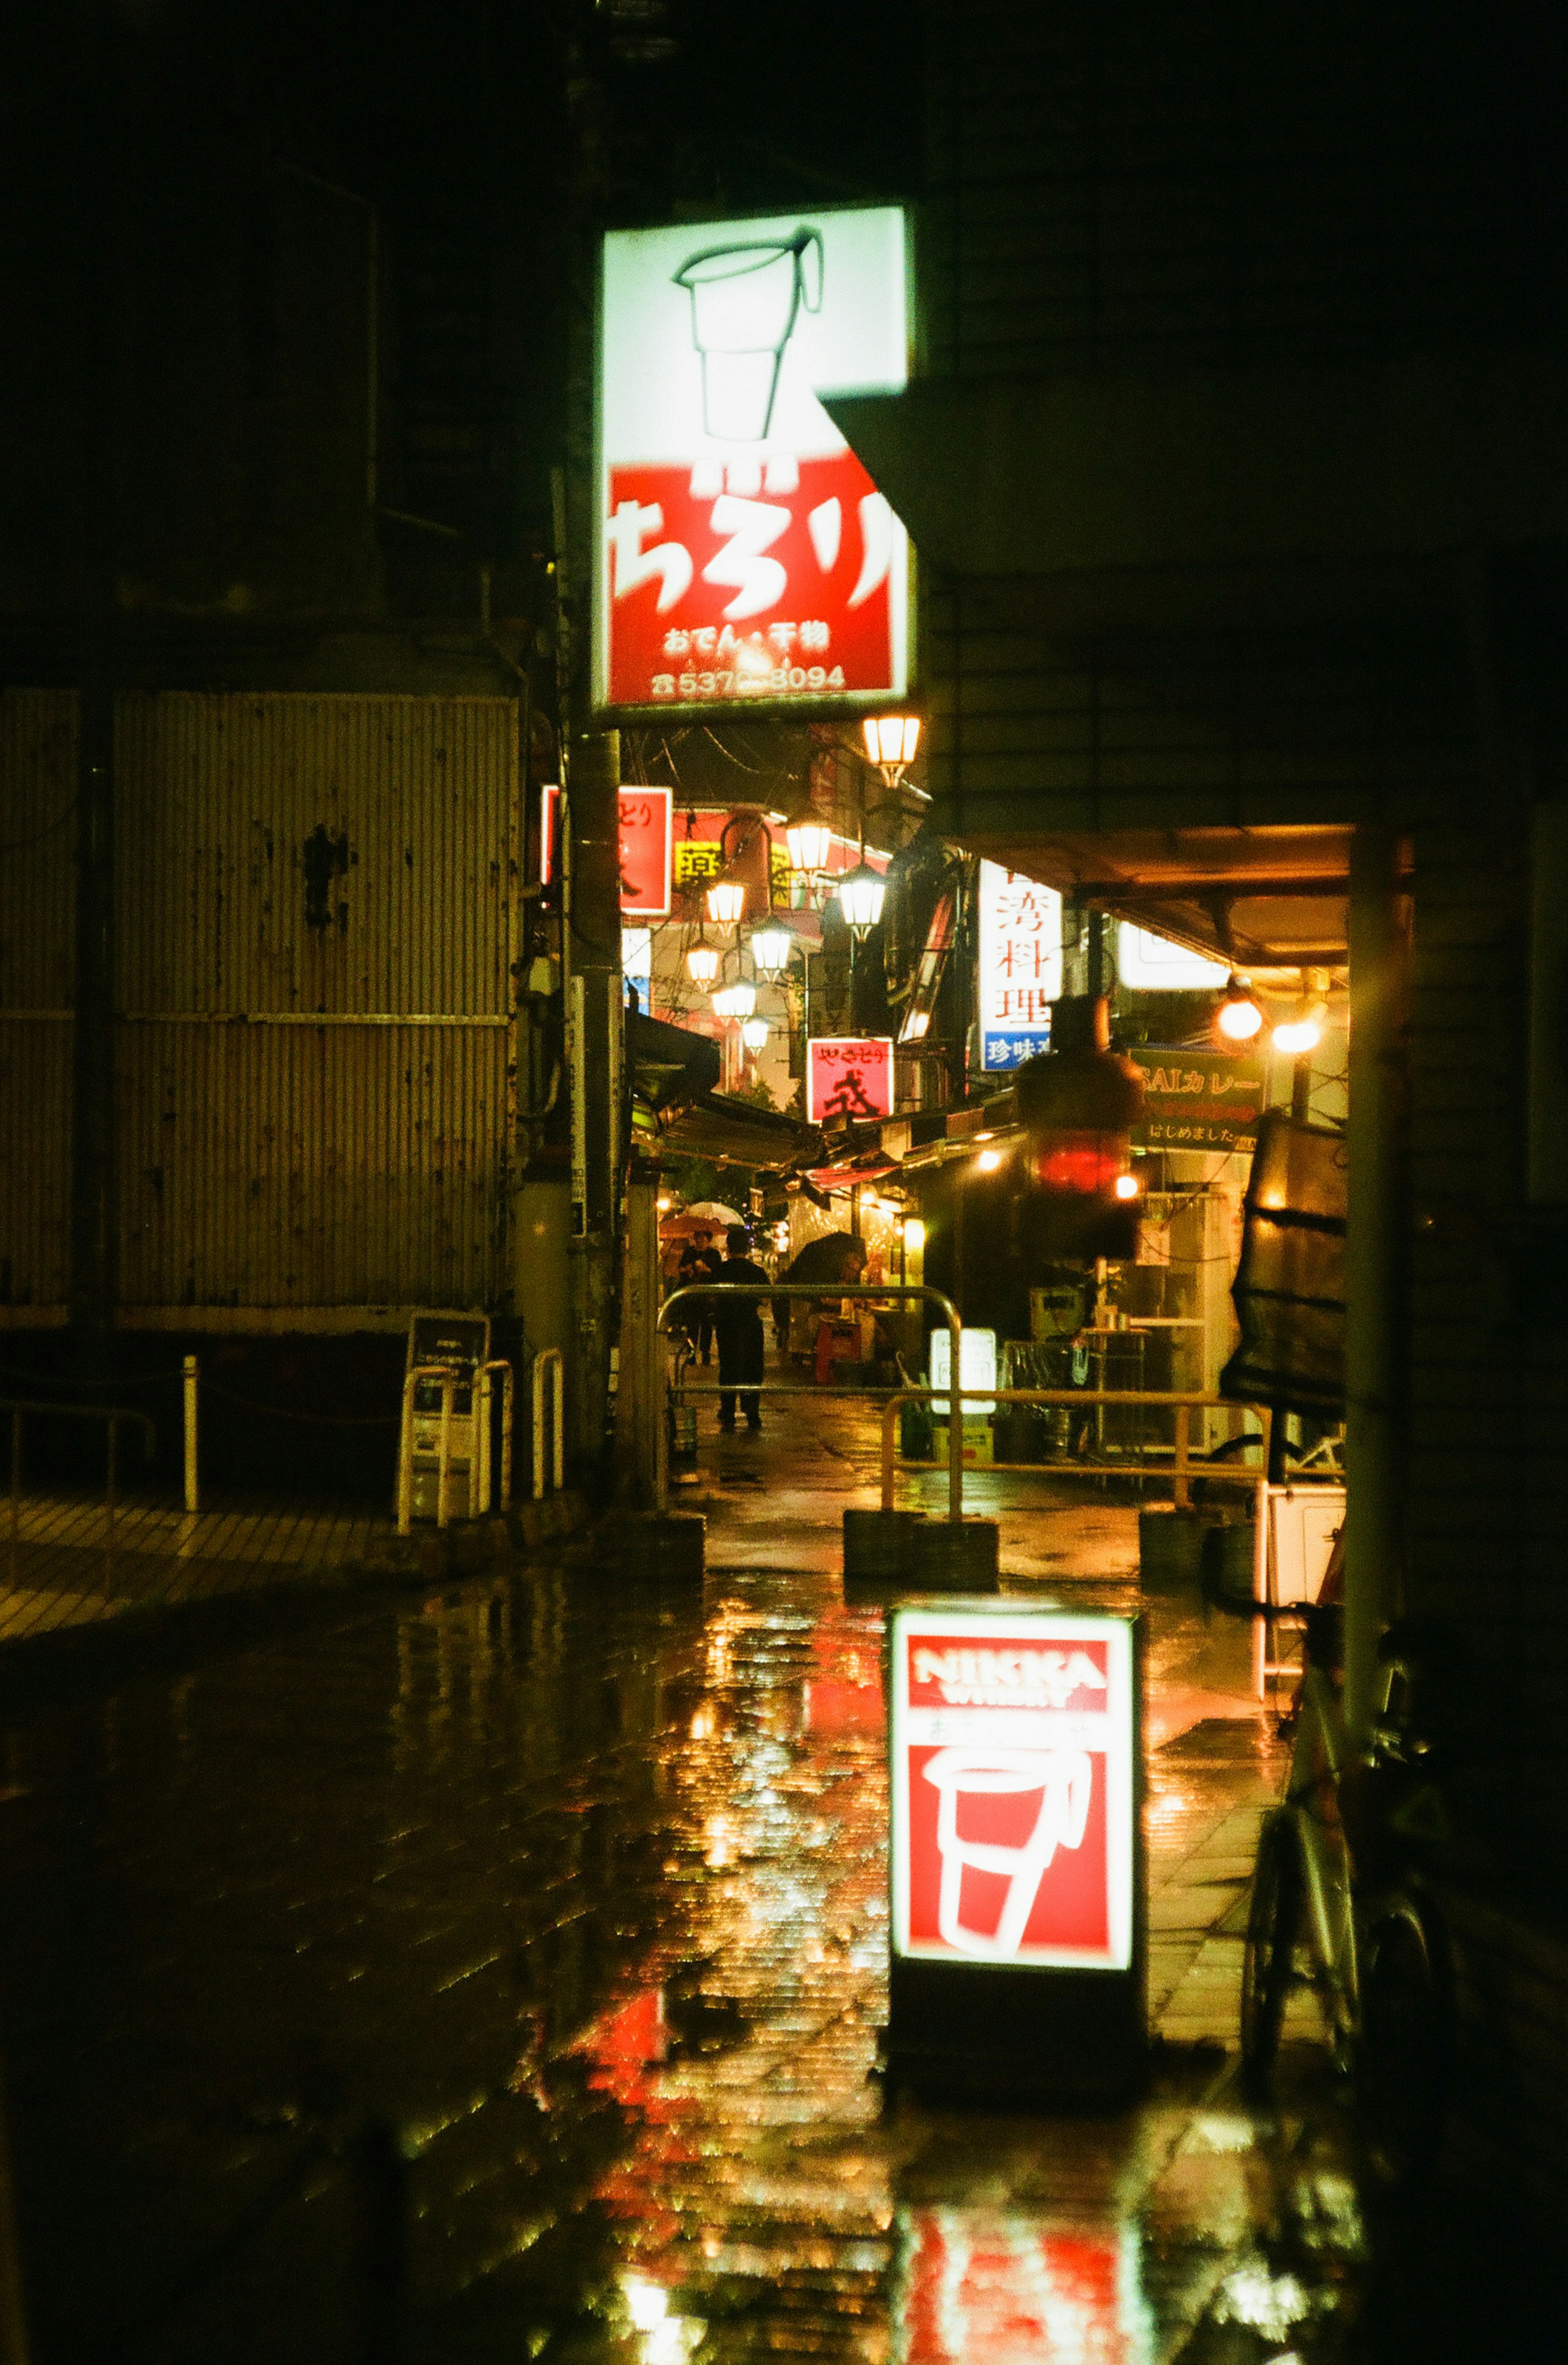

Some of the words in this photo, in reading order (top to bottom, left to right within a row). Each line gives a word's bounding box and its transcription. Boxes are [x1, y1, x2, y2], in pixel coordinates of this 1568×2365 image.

[606, 491, 893, 620] ちろり
[664, 620, 829, 653] おでん・干物
[995, 871, 1051, 1023] 湾料理
[1150, 1124, 1234, 1142] はじめました
[915, 1650, 1106, 1689] NIKKA
